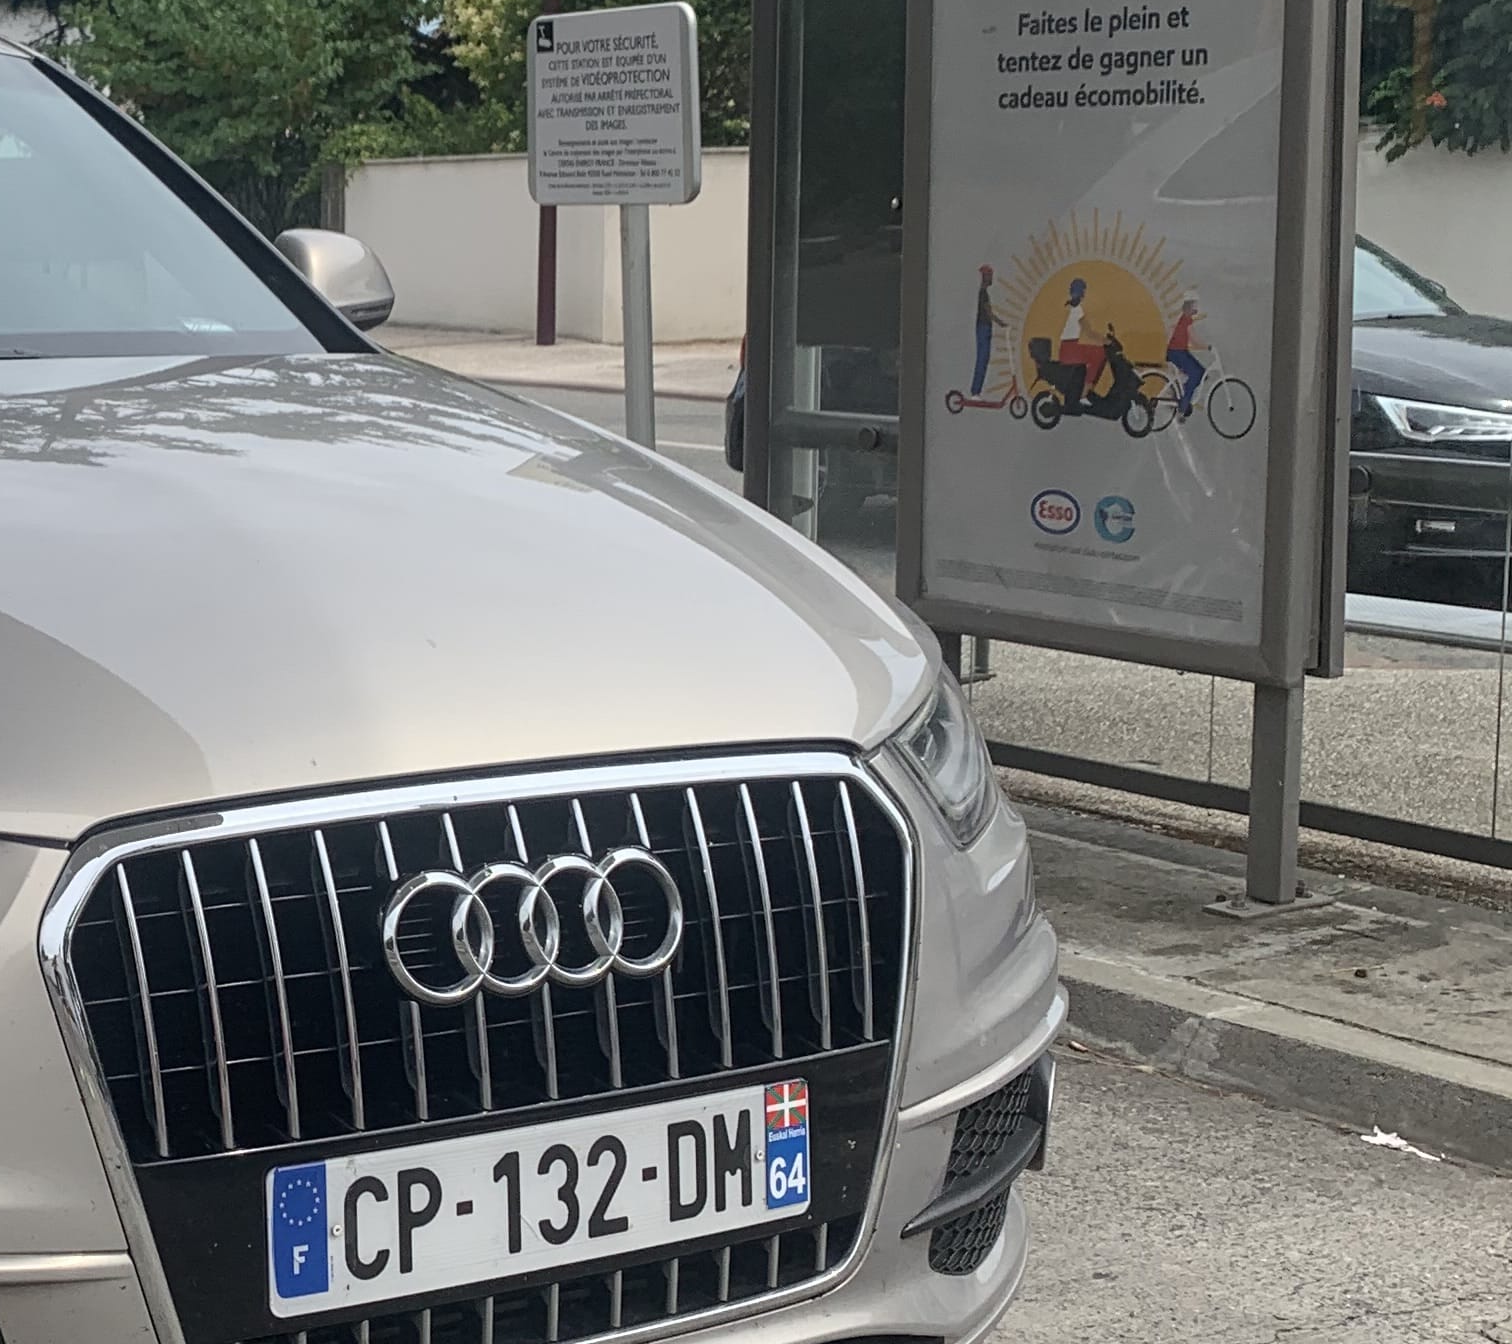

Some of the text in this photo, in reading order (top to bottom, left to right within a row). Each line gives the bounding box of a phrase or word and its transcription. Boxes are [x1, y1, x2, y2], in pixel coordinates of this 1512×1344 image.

[1018, 5, 1190, 38] Faites le plein et
[556, 41, 580, 55] POUR
[582, 39, 610, 53] VOTRE
[548, 60, 568, 71] CETTE
[571, 58, 599, 70] STATION
[602, 57, 612, 68] EST
[998, 46, 1208, 76] tentez de gagner un
[570, 76, 580, 87] DE
[582, 69, 670, 86] VIDÉOPROTECTION
[584, 92, 596, 101] PAR
[998, 80, 1205, 109] cadeau écomobilité.
[607, 106, 615, 116] ET
[585, 120, 598, 131] DES
[770, 1152, 806, 1200] 64
[344, 1109, 753, 1281] CP-132-DM
[293, 1244, 309, 1275] F
